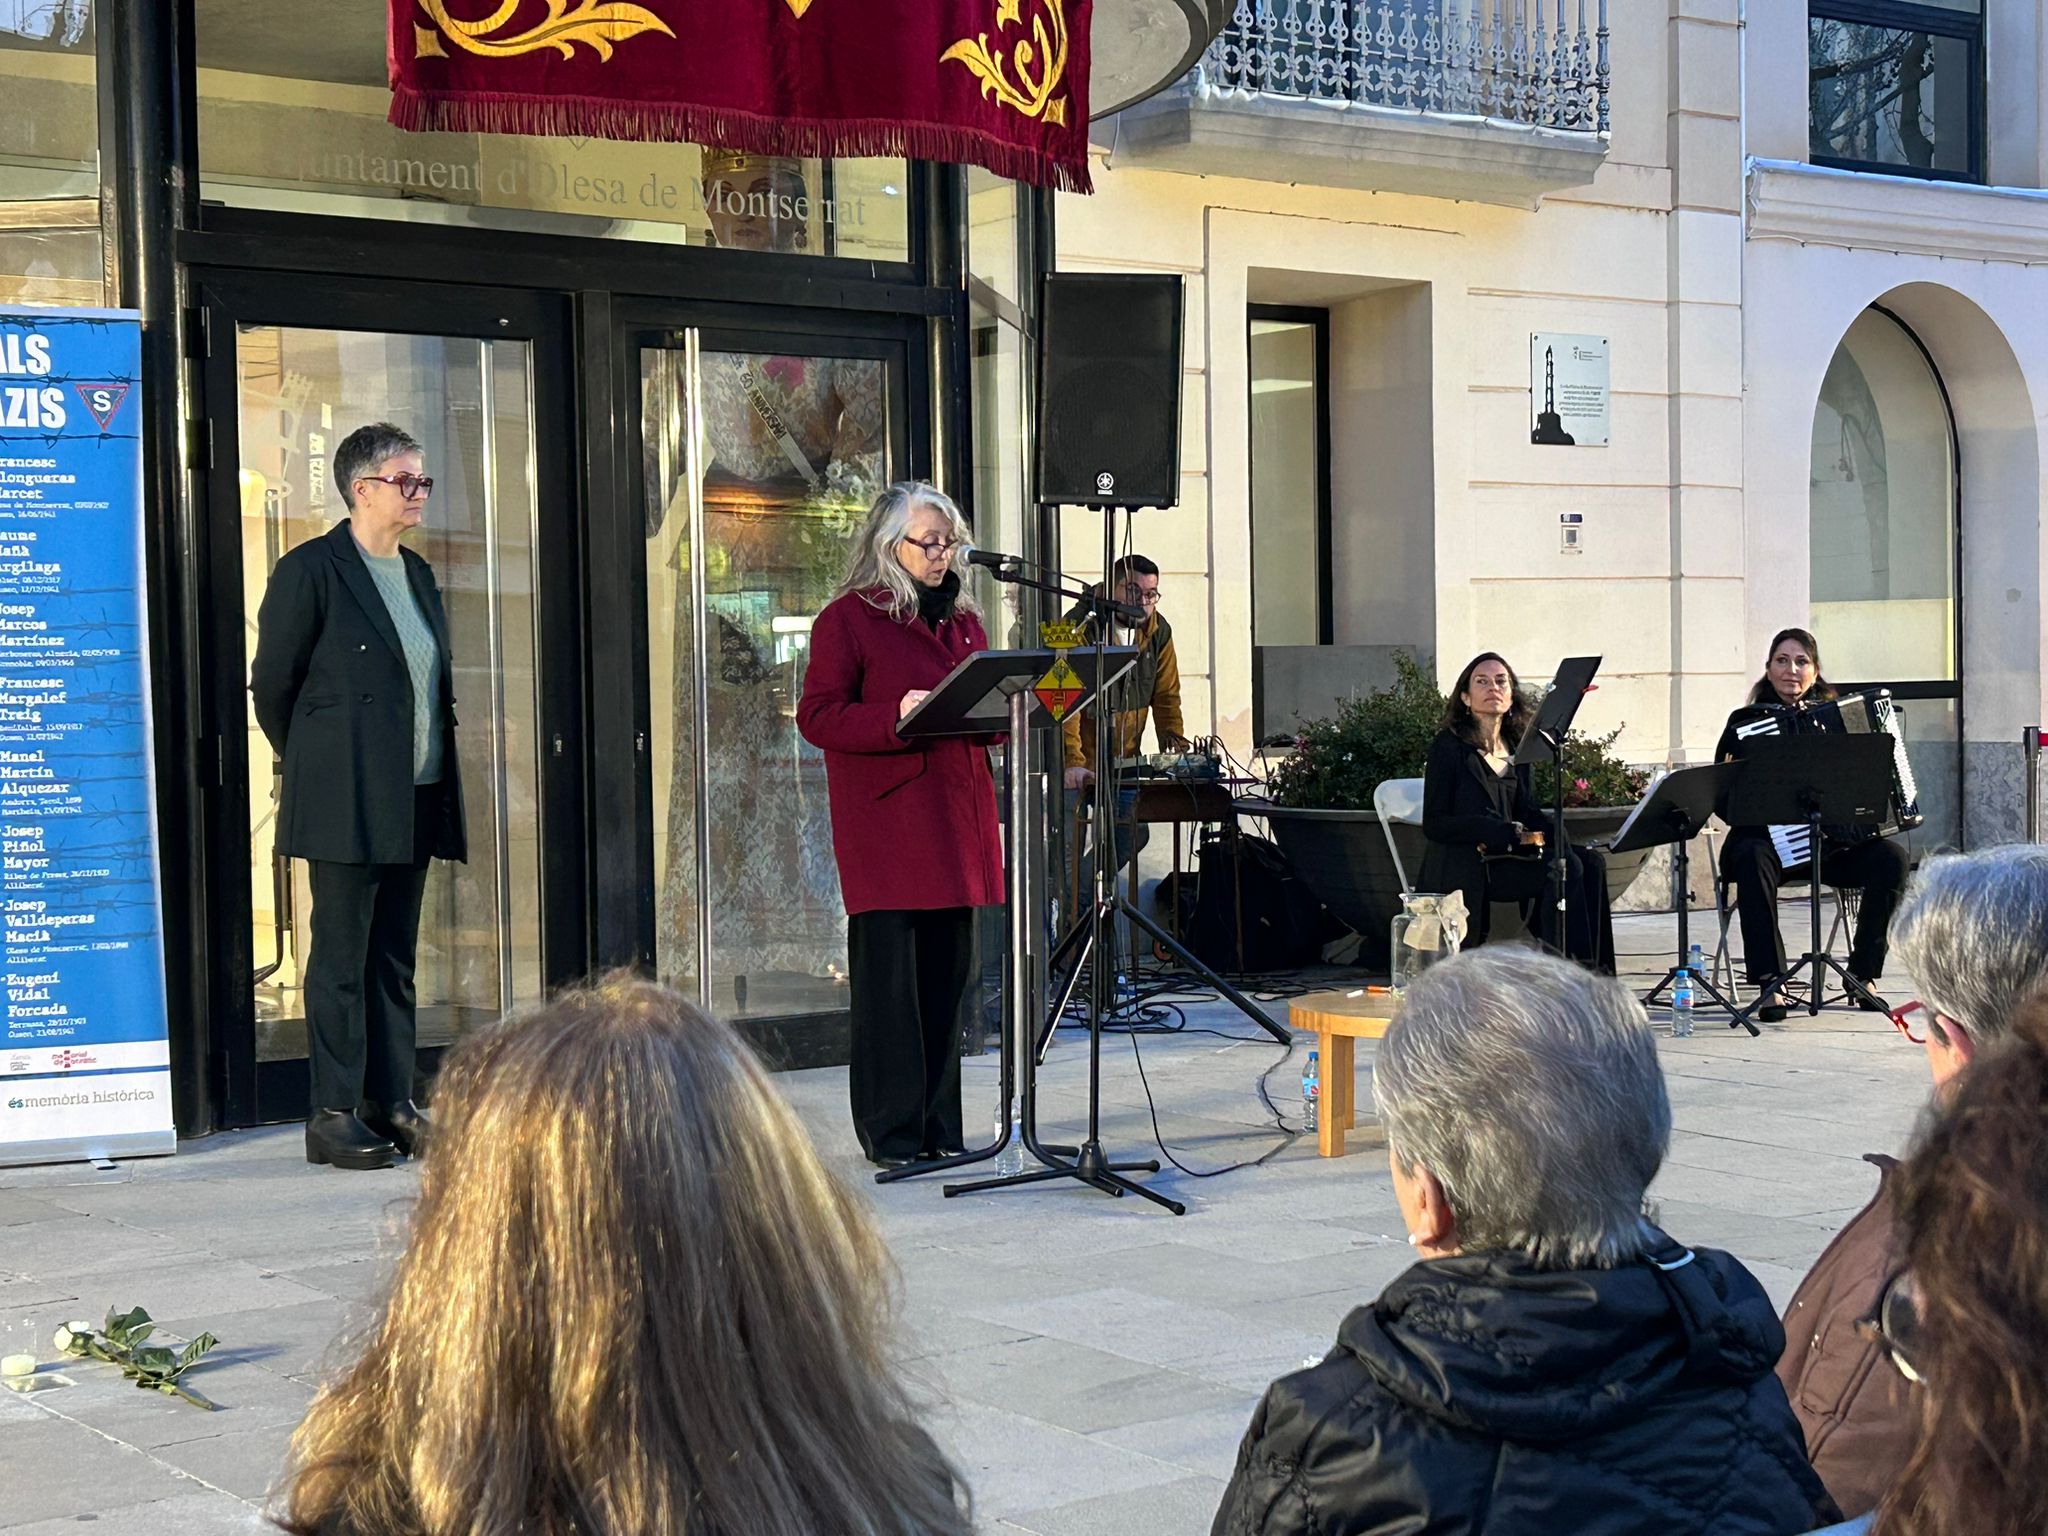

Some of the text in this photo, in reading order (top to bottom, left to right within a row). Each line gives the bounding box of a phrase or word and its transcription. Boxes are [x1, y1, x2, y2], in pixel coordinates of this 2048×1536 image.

[639, 173, 680, 208] de
[689, 177, 866, 226] Montserrat
[93, 390, 111, 412] S
[0, 708, 42, 723] Treig
[0, 750, 45, 763] Manel
[1, 766, 54, 778] Martín
[1, 782, 70, 797] Alquezar
[2, 825, 44, 839] Josep
[3, 840, 46, 853] Piñol
[4, 856, 50, 871] Mayor
[4, 899, 47, 913] Josep
[5, 914, 96, 928] Valldeperas
[5, 930, 51, 943] Macià
[7, 971, 61, 987] Eugeni
[7, 988, 50, 1001] Vidal
[8, 1003, 68, 1017] Forcada
